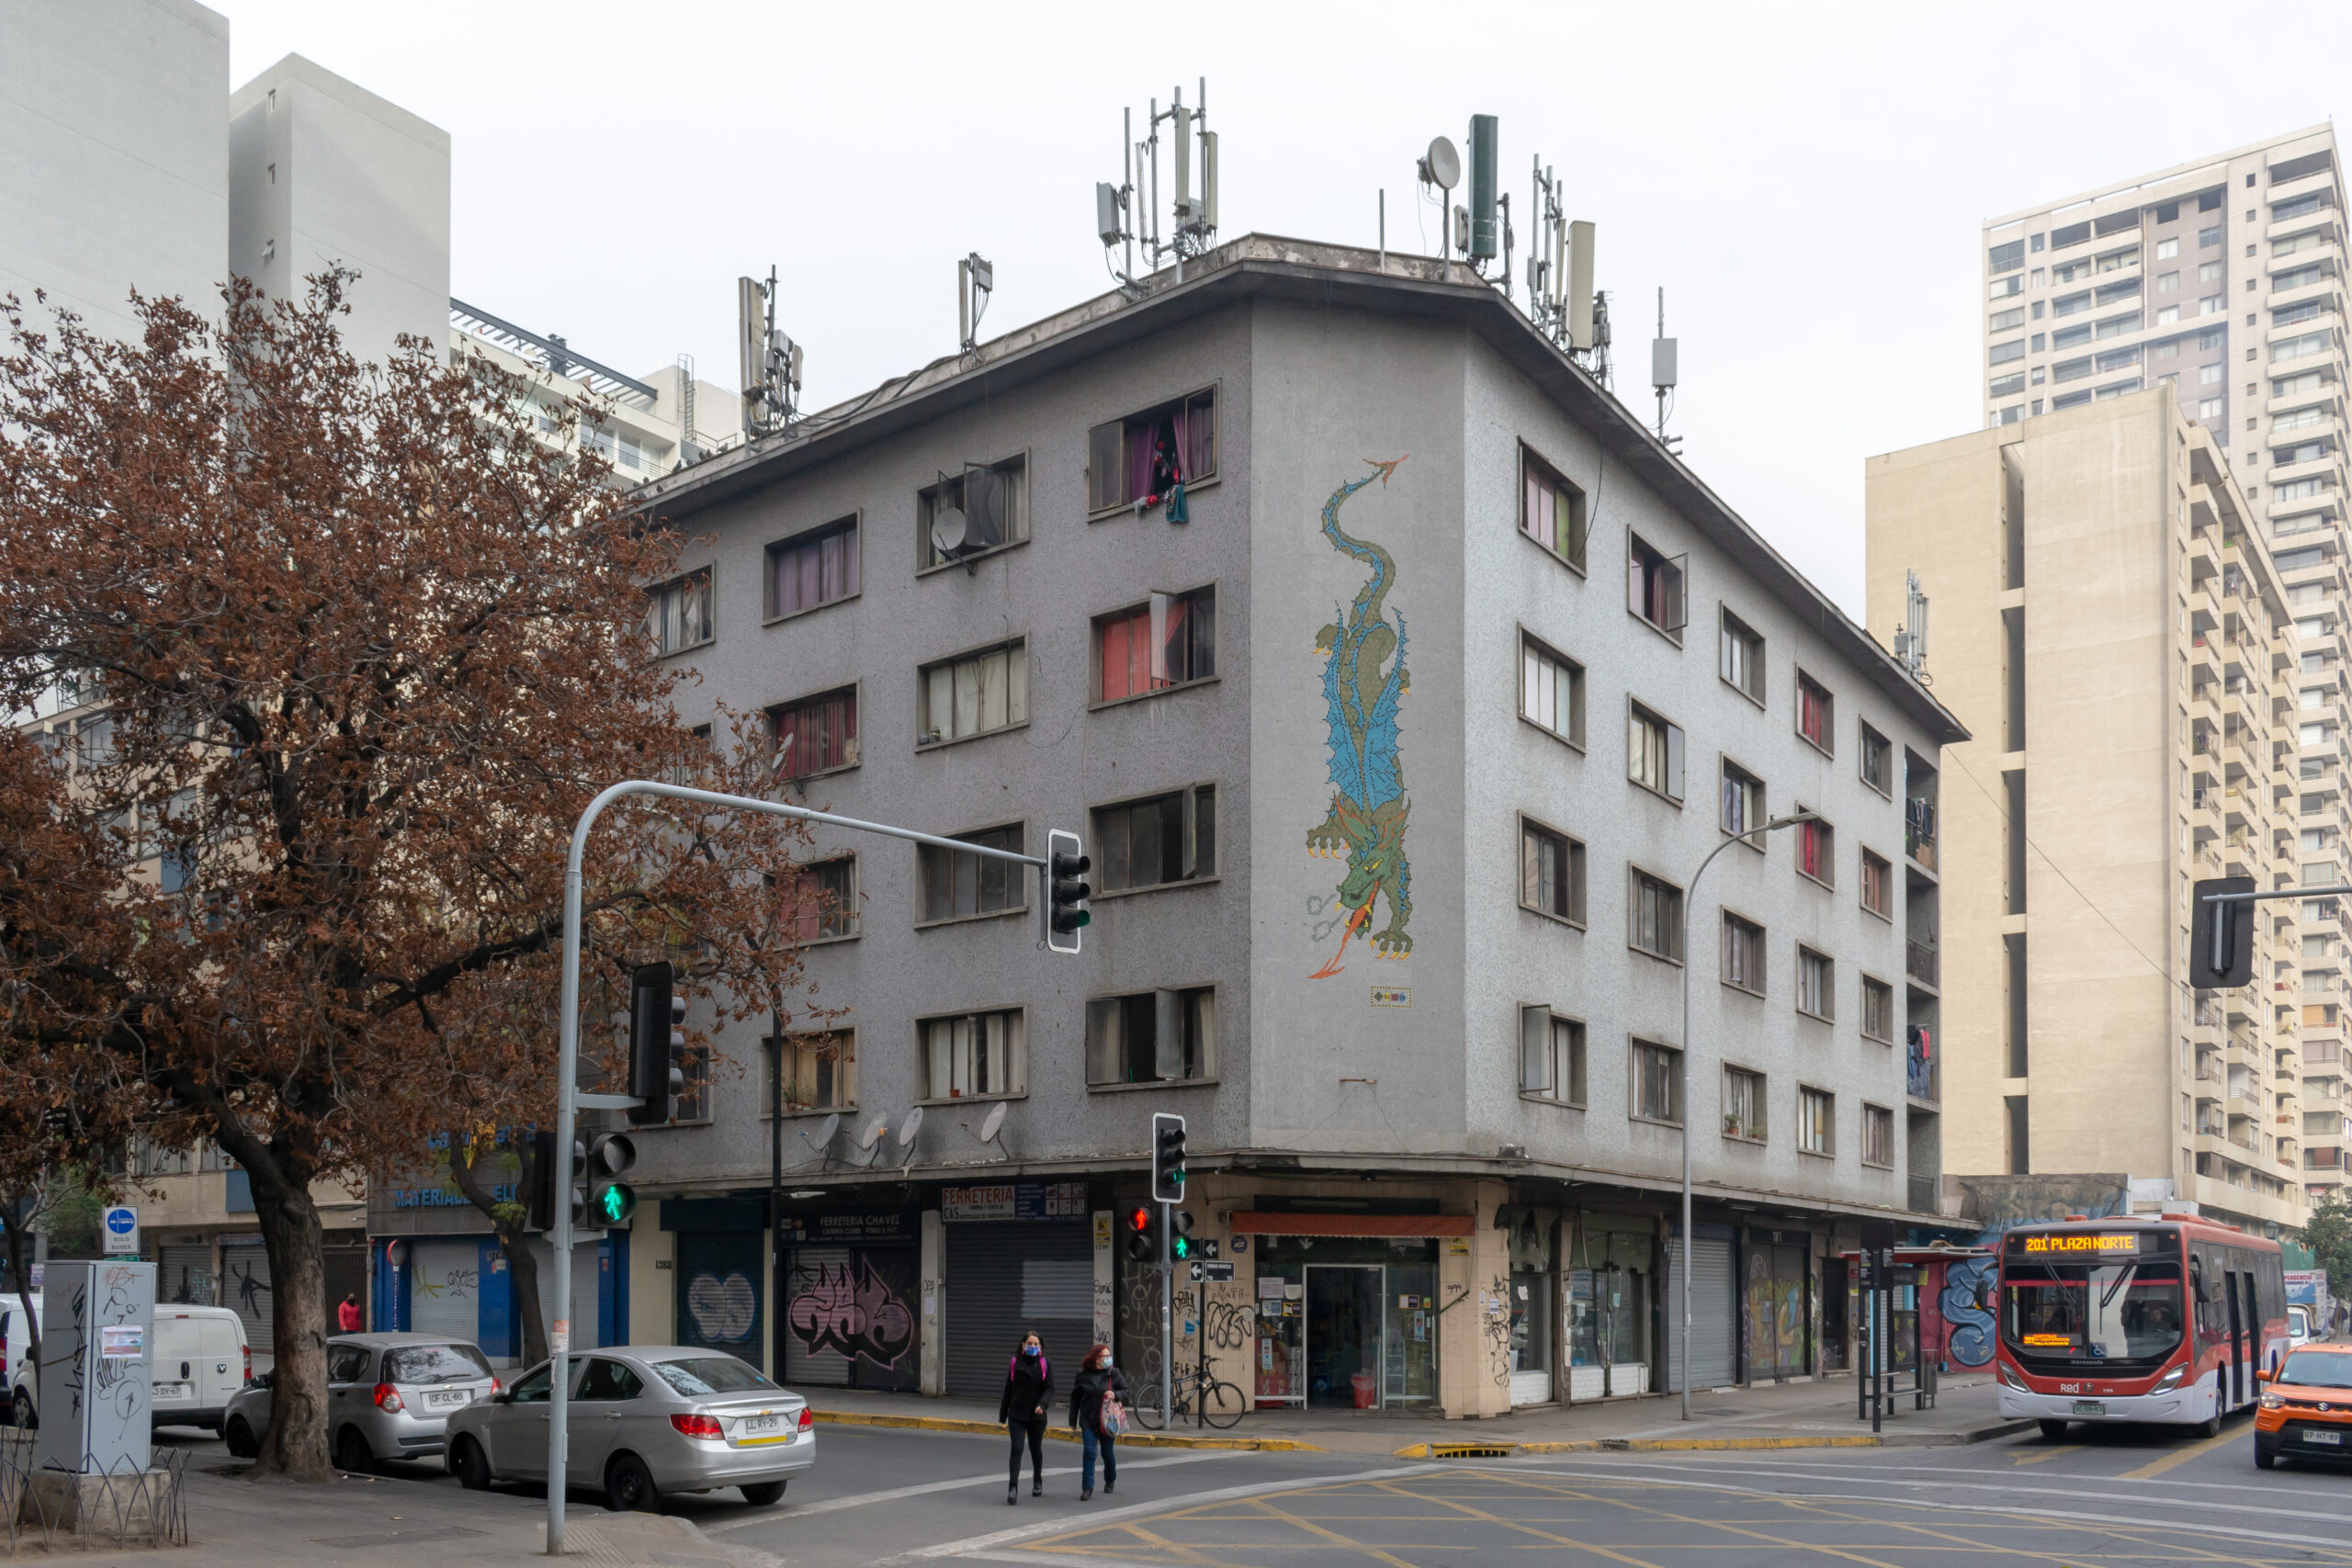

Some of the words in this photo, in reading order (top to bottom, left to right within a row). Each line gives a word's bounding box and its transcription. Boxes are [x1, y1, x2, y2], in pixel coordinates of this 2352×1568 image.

[943, 1188, 1013, 1204] FERRETERIA
[820, 1216, 864, 1227] FERRETERIA
[865, 1214, 900, 1226] CHAVEZ
[2026, 1237, 2048, 1251] 201
[2051, 1236, 2092, 1250] PLAZA
[2093, 1235, 2134, 1249] NORTE
[2060, 1382, 2079, 1393] Red
